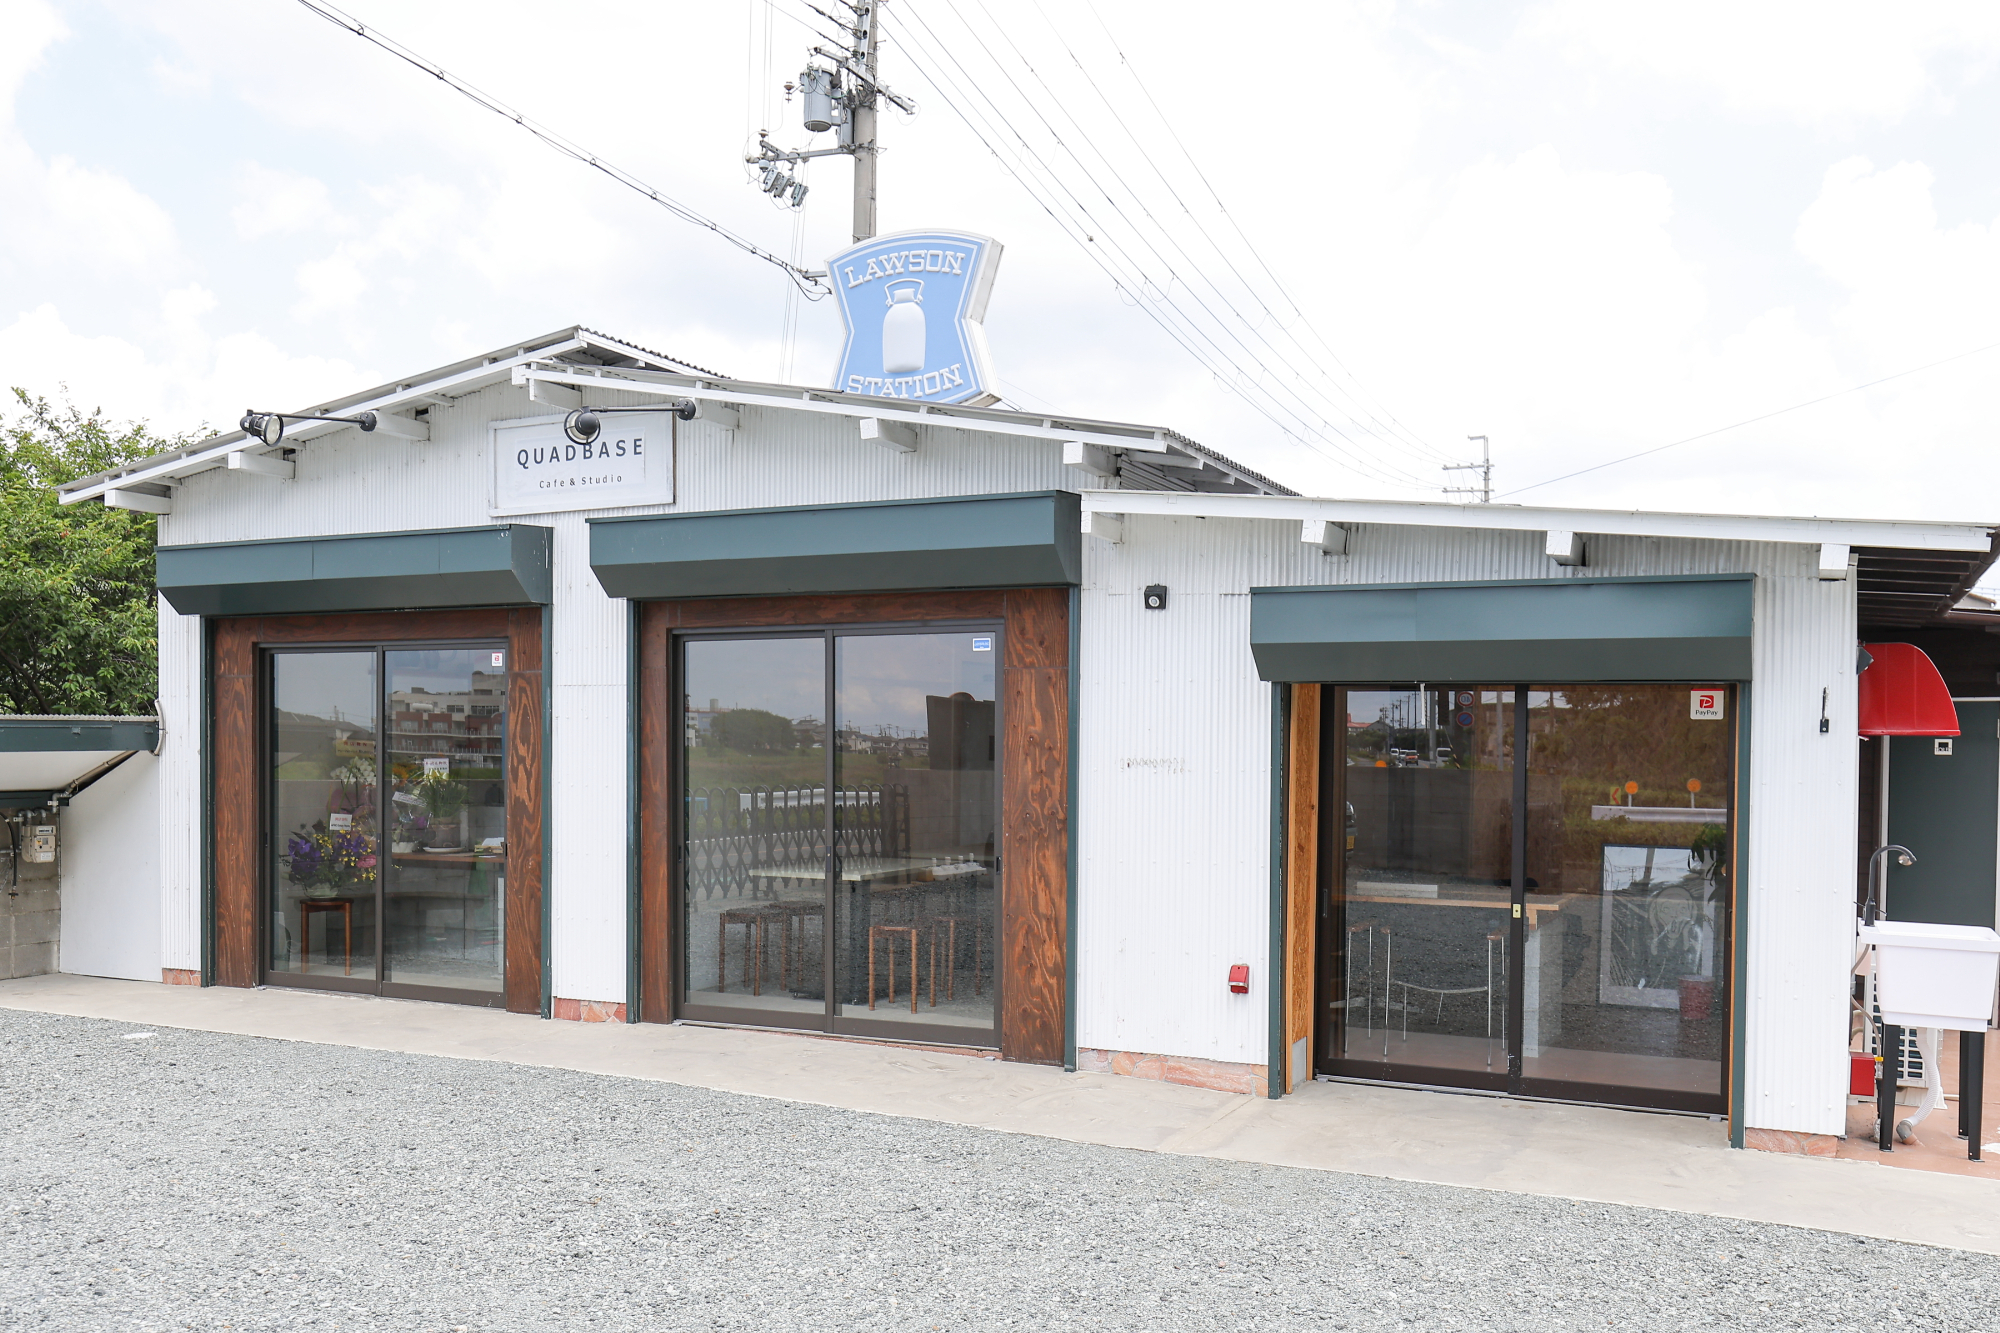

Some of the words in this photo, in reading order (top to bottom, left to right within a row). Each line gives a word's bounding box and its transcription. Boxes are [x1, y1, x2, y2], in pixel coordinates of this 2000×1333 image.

[844, 250, 966, 289] LAWSON
[846, 363, 964, 399] STATION
[517, 438, 643, 470] QUADBASE
[539, 478, 565, 489] Cafe
[569, 477, 576, 487] &
[581, 474, 622, 486] Studio
